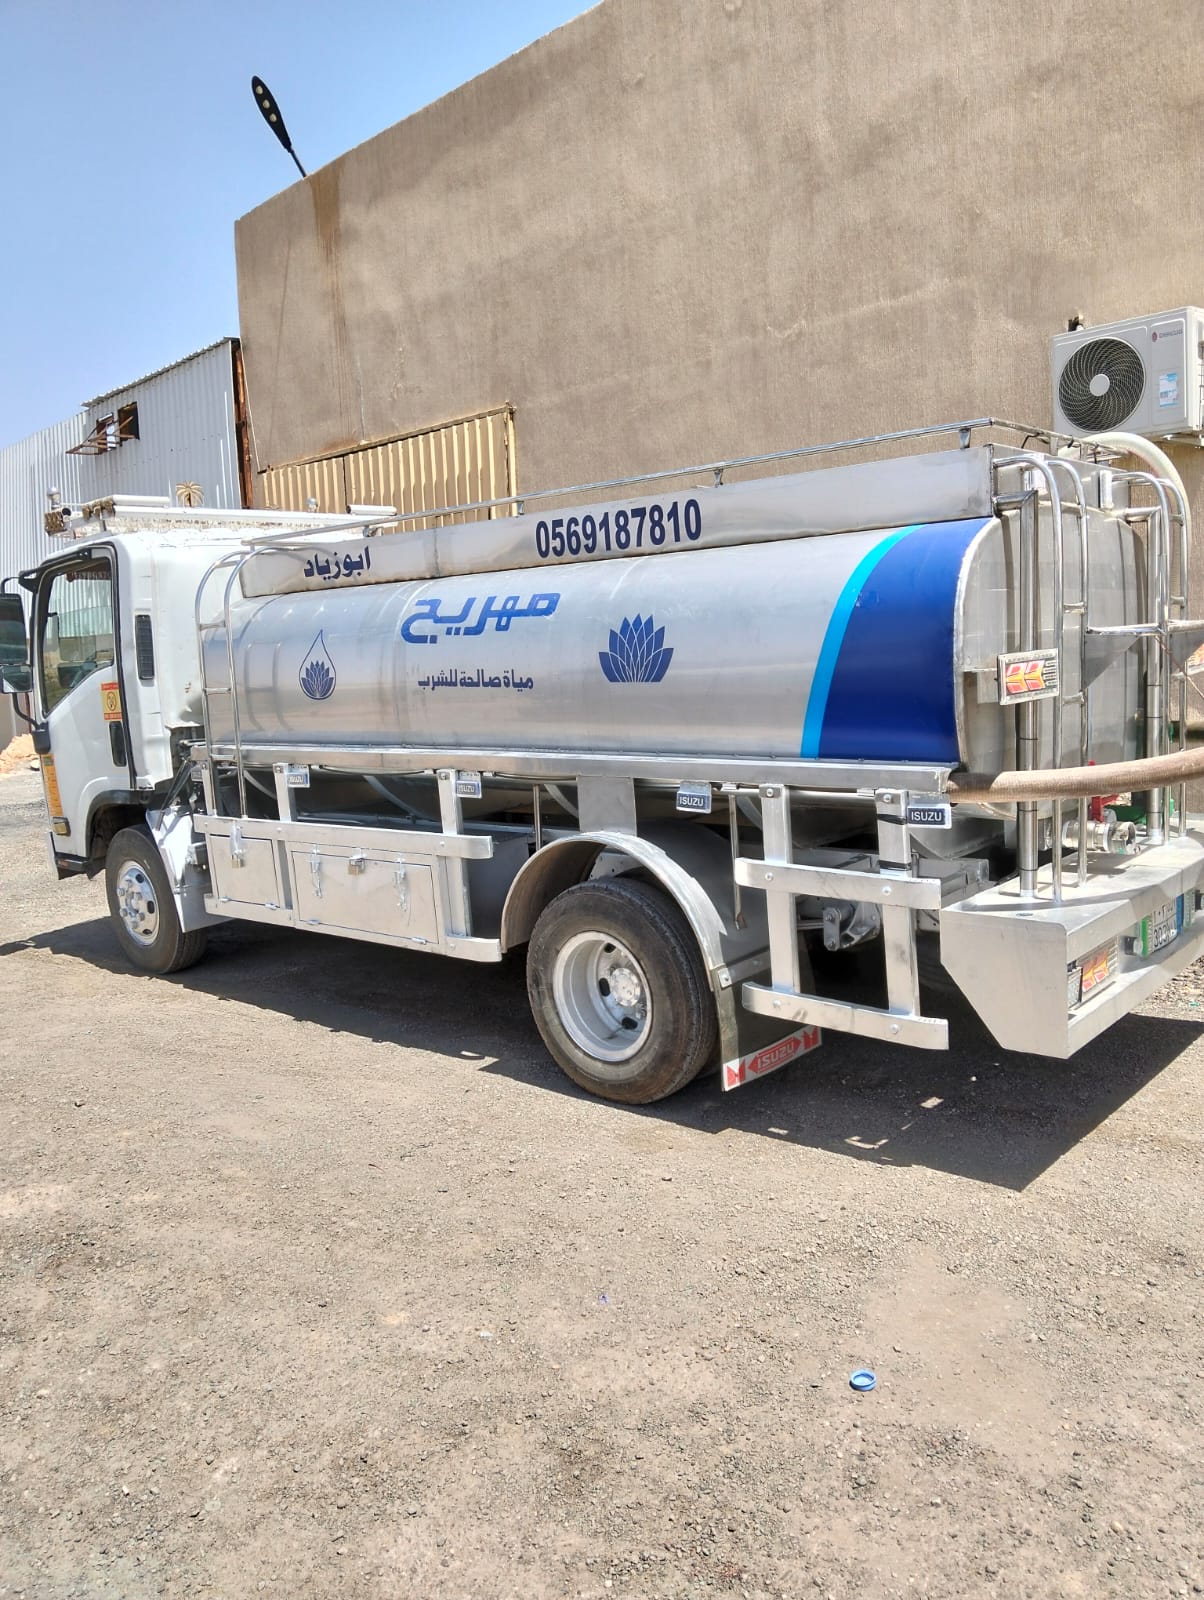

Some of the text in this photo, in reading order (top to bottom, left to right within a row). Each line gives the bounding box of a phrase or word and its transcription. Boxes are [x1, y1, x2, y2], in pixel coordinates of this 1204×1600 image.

[536, 499, 702, 559] 0569187810
[418, 668, 458, 691] للشرب
[459, 668, 502, 689] صالحة
[458, 783, 476, 793] ISUZU
[679, 795, 705, 807] ISUZU
[910, 811, 943, 822] ISUZU
[757, 1042, 795, 1068] ISUZU
